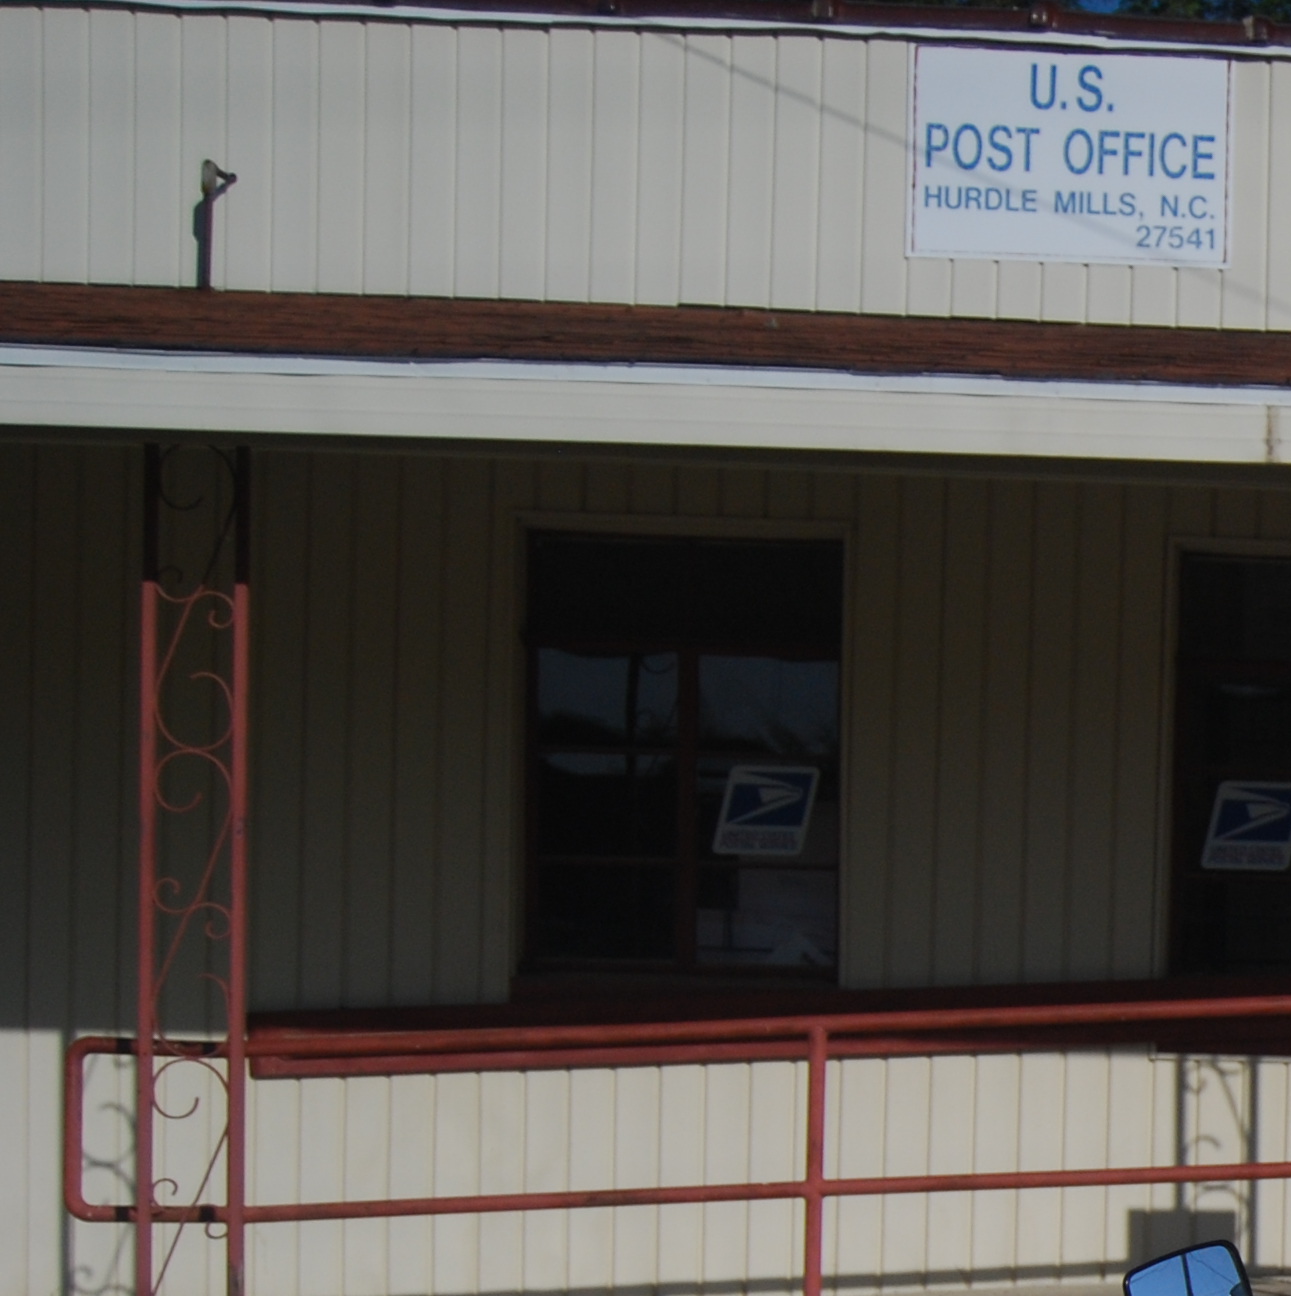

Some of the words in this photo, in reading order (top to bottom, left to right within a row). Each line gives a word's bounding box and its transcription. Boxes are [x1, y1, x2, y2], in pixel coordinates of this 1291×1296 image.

[1030, 63, 1115, 113] U.S.
[925, 123, 1040, 172] POST
[1063, 129, 1216, 180] OFFICE
[924, 186, 1038, 213] HURDLE
[1054, 191, 1144, 221] MILLS,
[1161, 195, 1216, 220] N.C.
[1136, 225, 1216, 250] 27541
